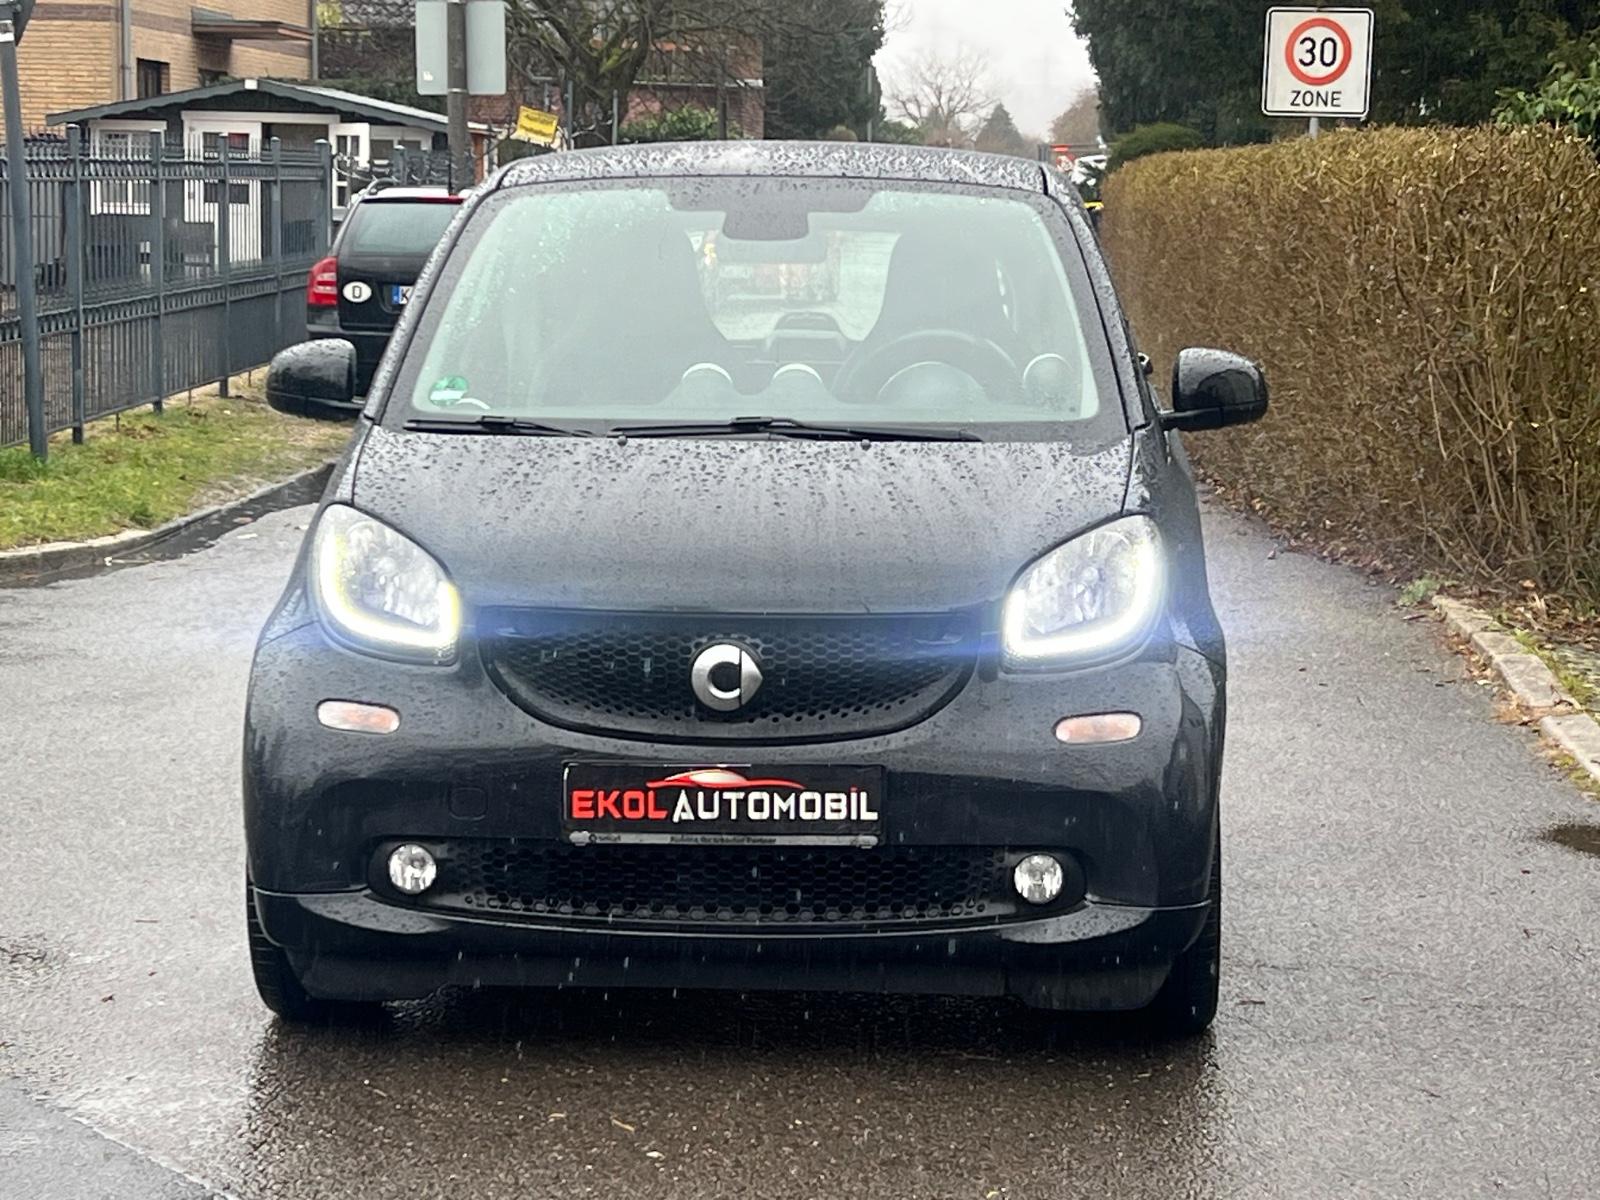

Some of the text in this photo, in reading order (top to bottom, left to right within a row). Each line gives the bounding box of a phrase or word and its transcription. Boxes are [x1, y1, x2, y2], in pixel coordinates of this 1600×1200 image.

[1298, 36, 1338, 68] 30
[1290, 89, 1343, 108] ZONE
[351, 285, 363, 300] D
[571, 789, 669, 819] EKOL
